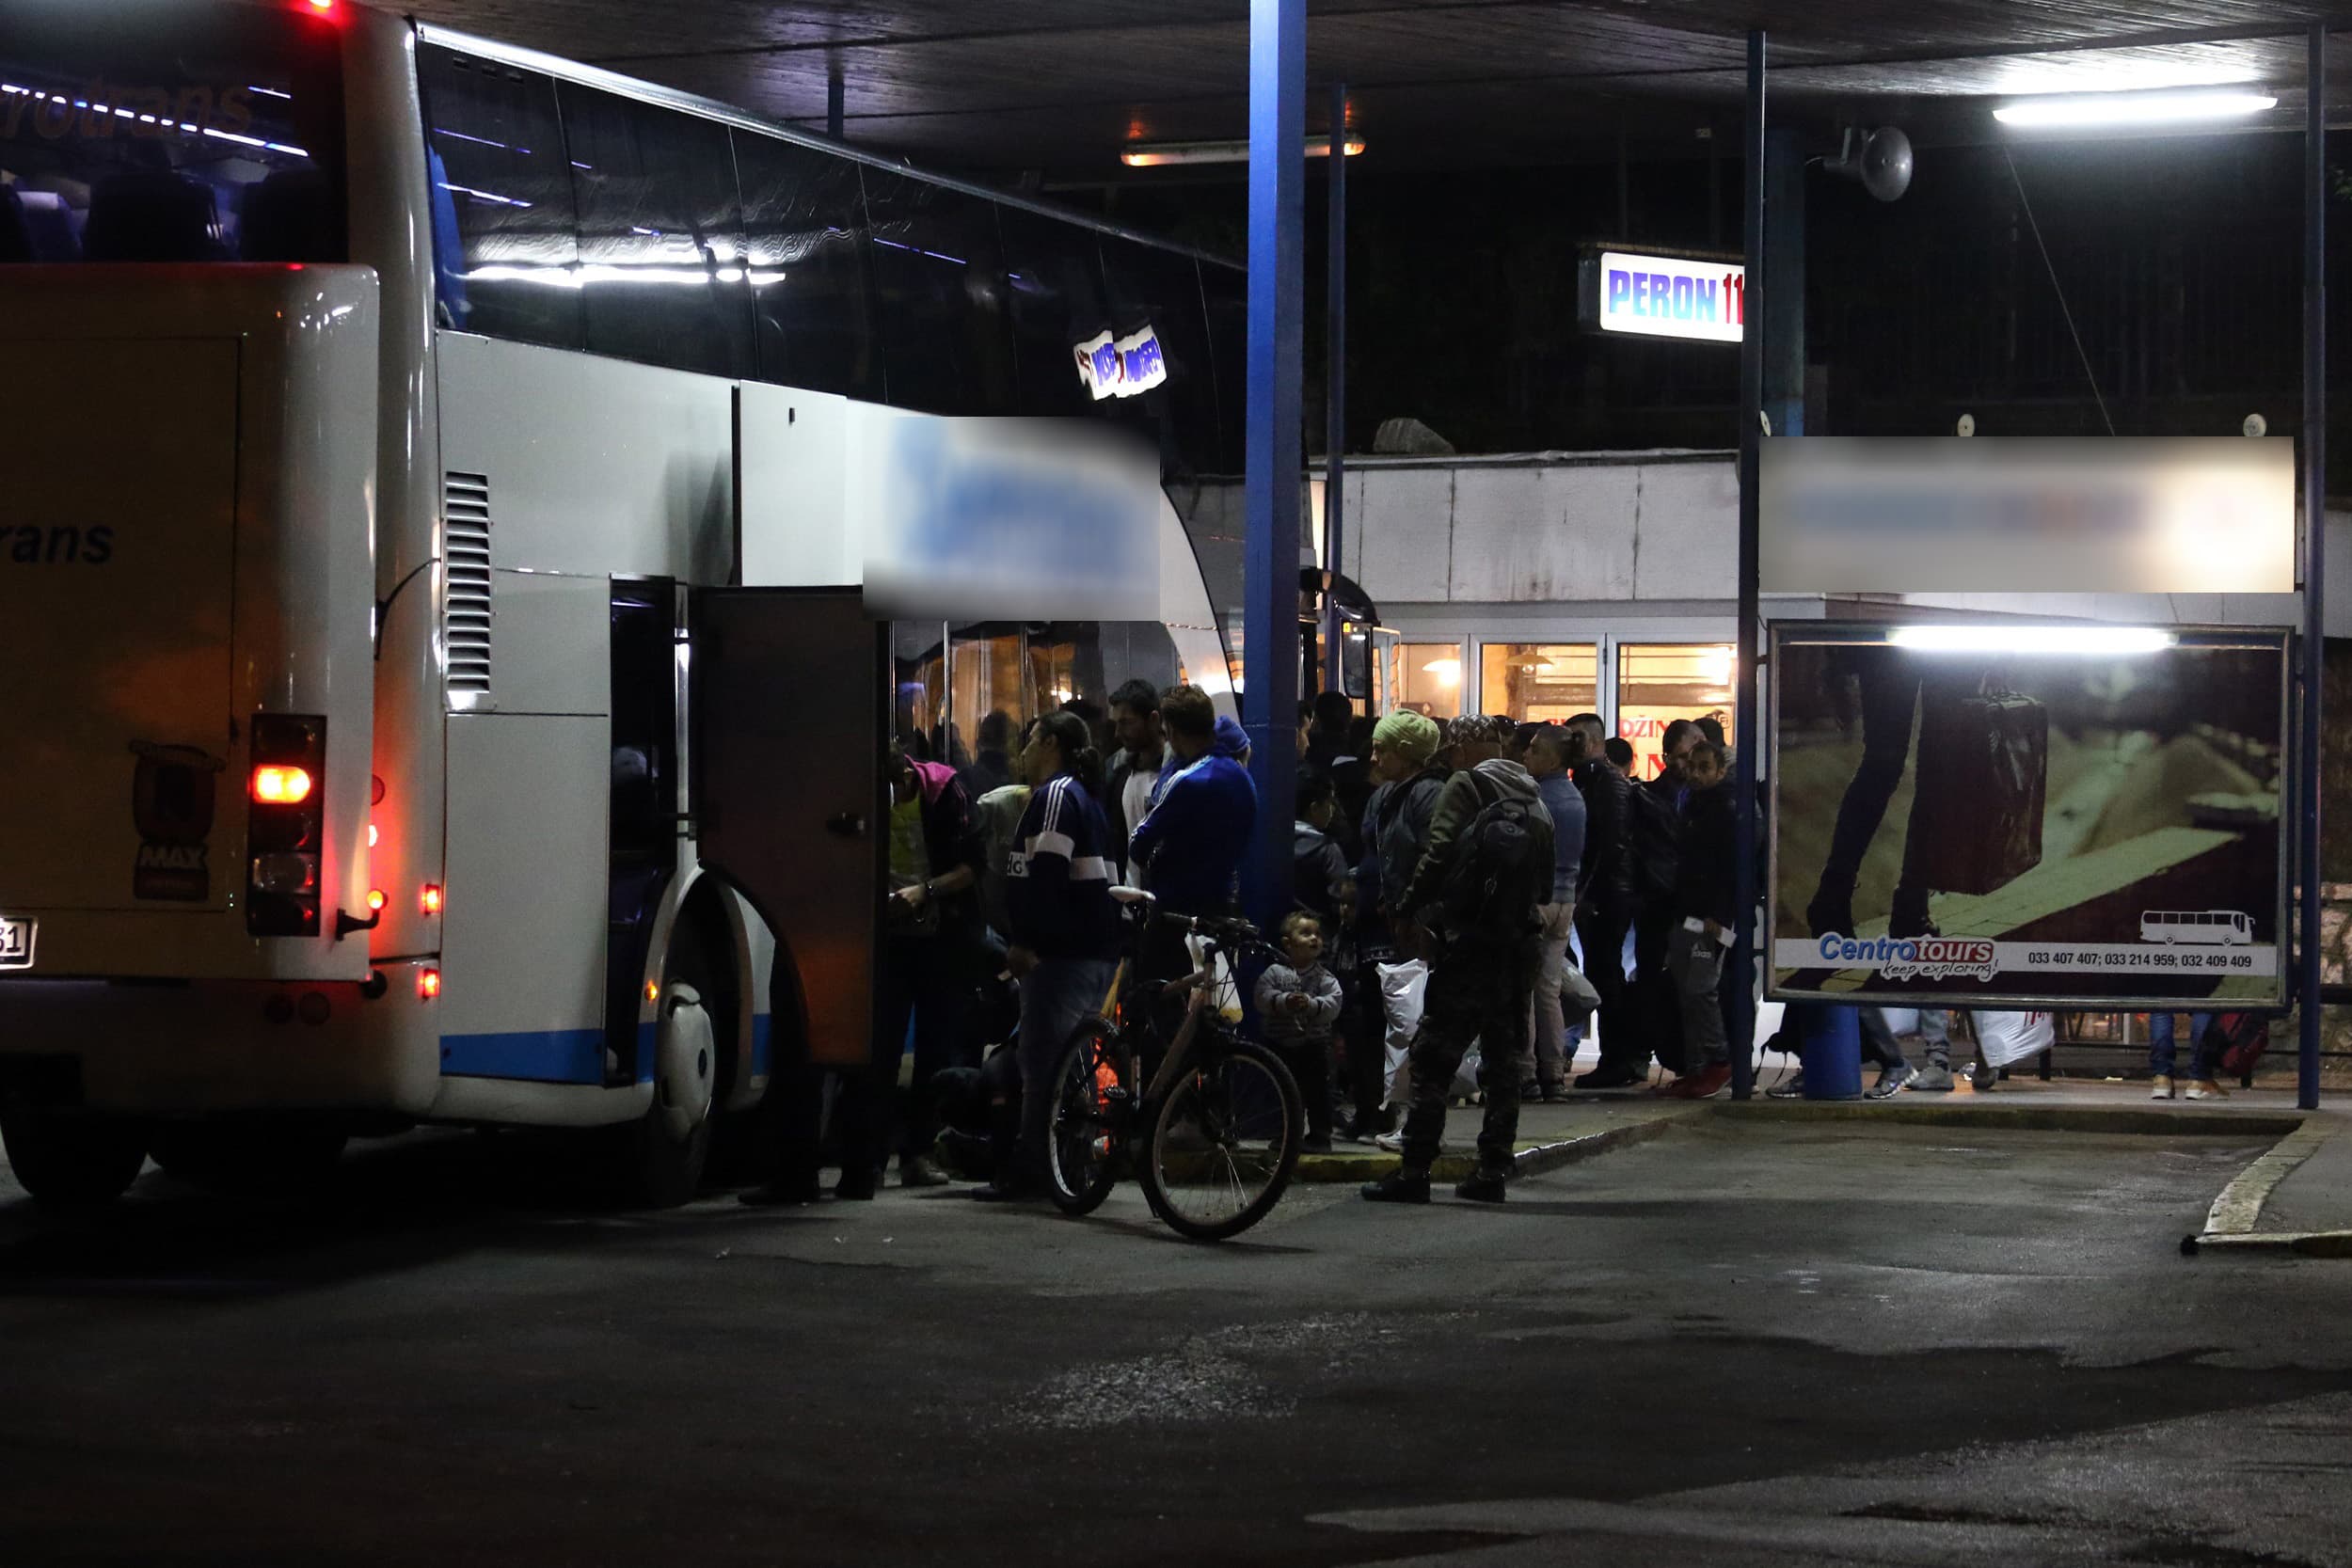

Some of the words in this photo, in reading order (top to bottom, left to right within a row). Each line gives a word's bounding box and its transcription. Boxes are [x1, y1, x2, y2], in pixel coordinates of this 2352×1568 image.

[1609, 269, 1717, 323] PERON
[1820, 934, 1994, 963] Centrotours
[2028, 952, 2050, 964] 033
[2053, 952, 2074, 965] 407
[2076, 953, 2102, 967] 407;
[2105, 953, 2126, 965] 033
[2129, 954, 2151, 966] 214
[2153, 954, 2178, 968] 959;
[2181, 955, 2202, 967] 032
[2205, 955, 2227, 967] 409
[2231, 956, 2252, 968] 409
[1883, 959, 1916, 975] keep
[1922, 958, 1998, 979] exploring!
